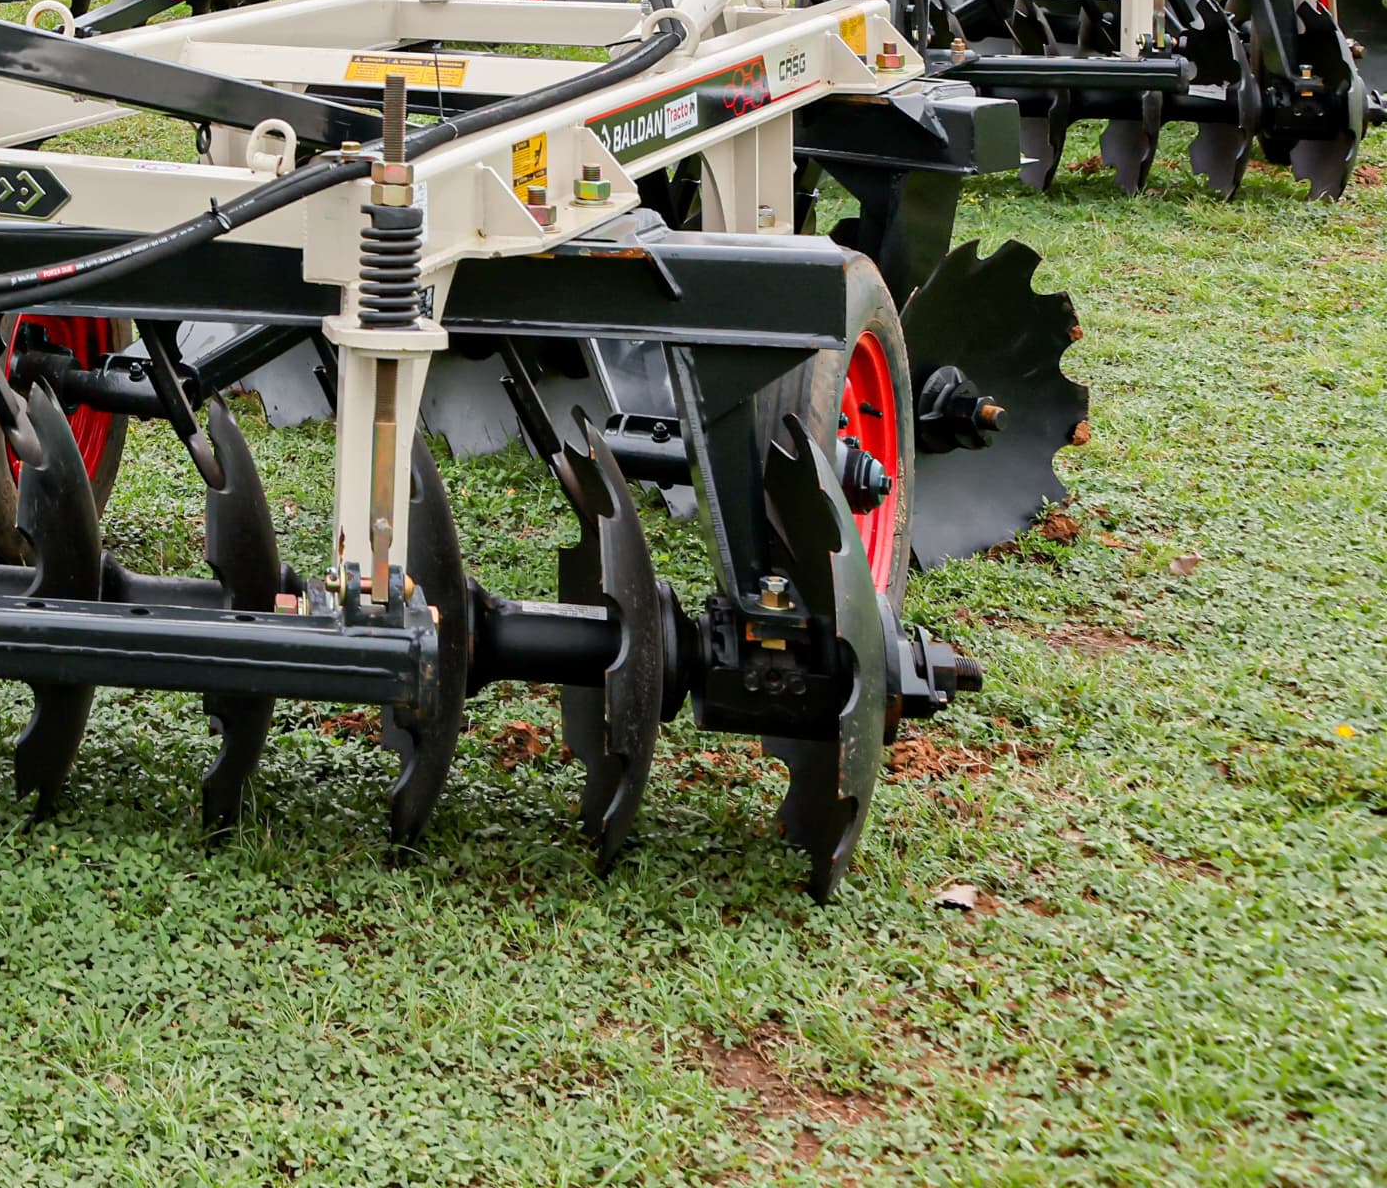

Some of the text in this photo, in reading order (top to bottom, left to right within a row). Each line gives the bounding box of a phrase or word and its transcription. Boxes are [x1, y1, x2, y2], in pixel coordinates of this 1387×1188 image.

[779, 52, 805, 81] CRSG
[666, 102, 689, 124] Tracto
[613, 107, 664, 153] BALDAN
